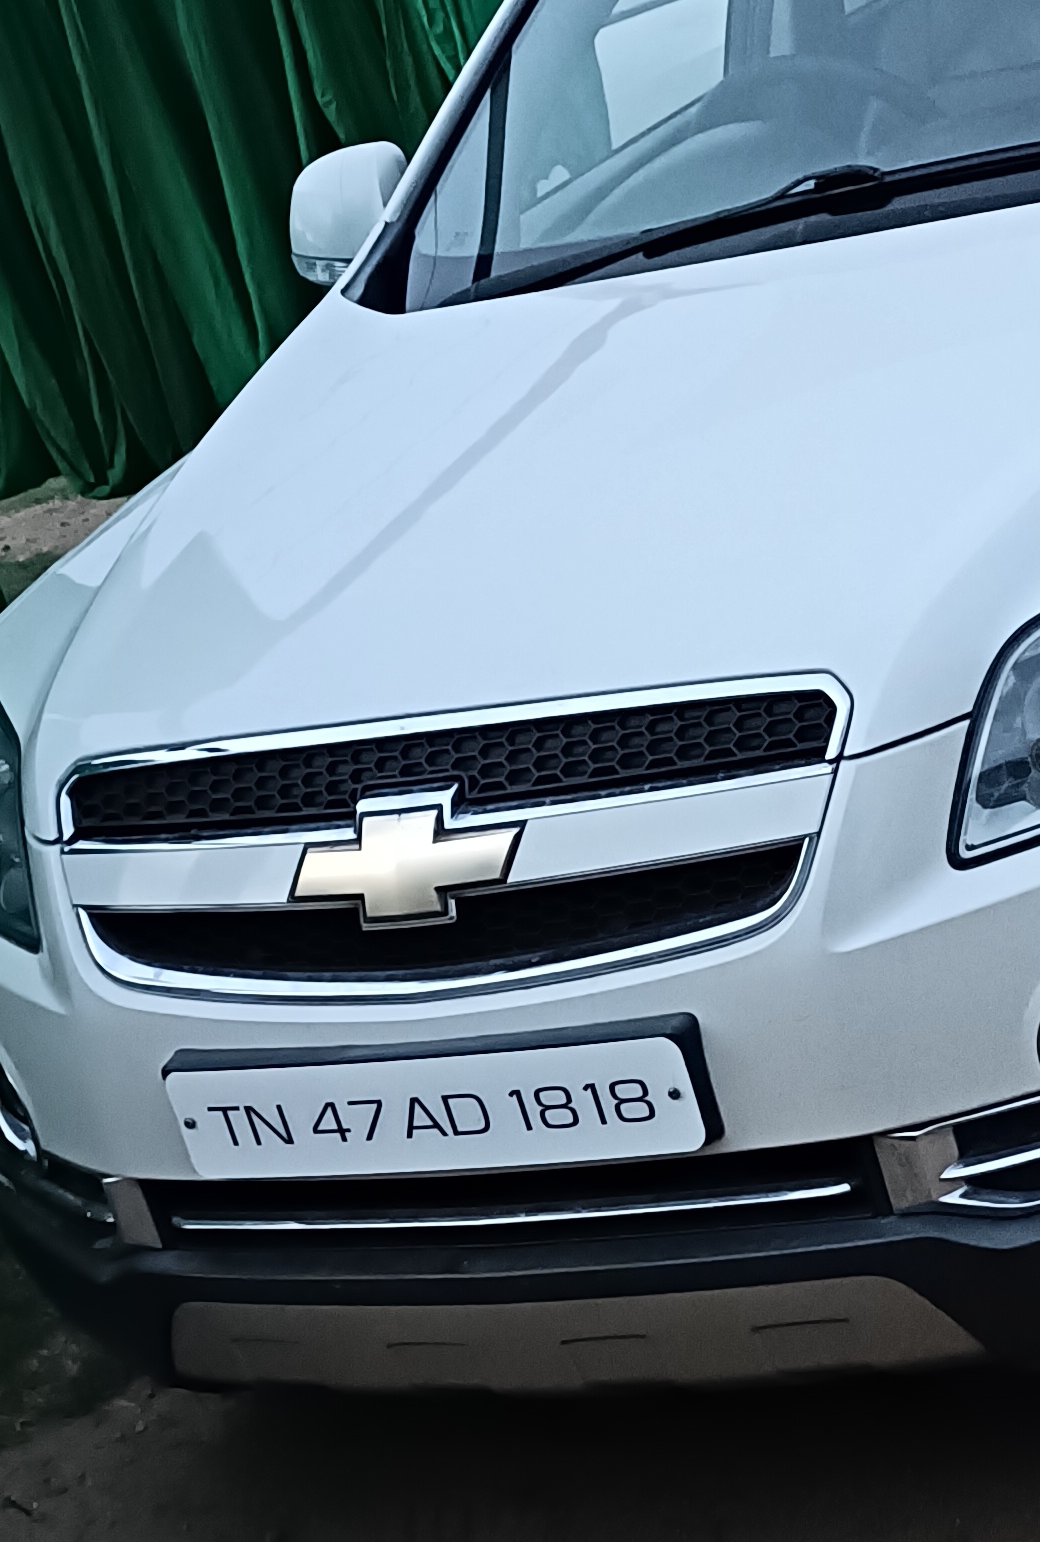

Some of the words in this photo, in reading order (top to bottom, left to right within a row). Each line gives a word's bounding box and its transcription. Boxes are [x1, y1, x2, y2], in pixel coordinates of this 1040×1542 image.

[206, 1104, 295, 1147] TN
[312, 1099, 384, 1143] 47
[405, 1092, 492, 1140] AD
[508, 1078, 657, 1132] 1818
